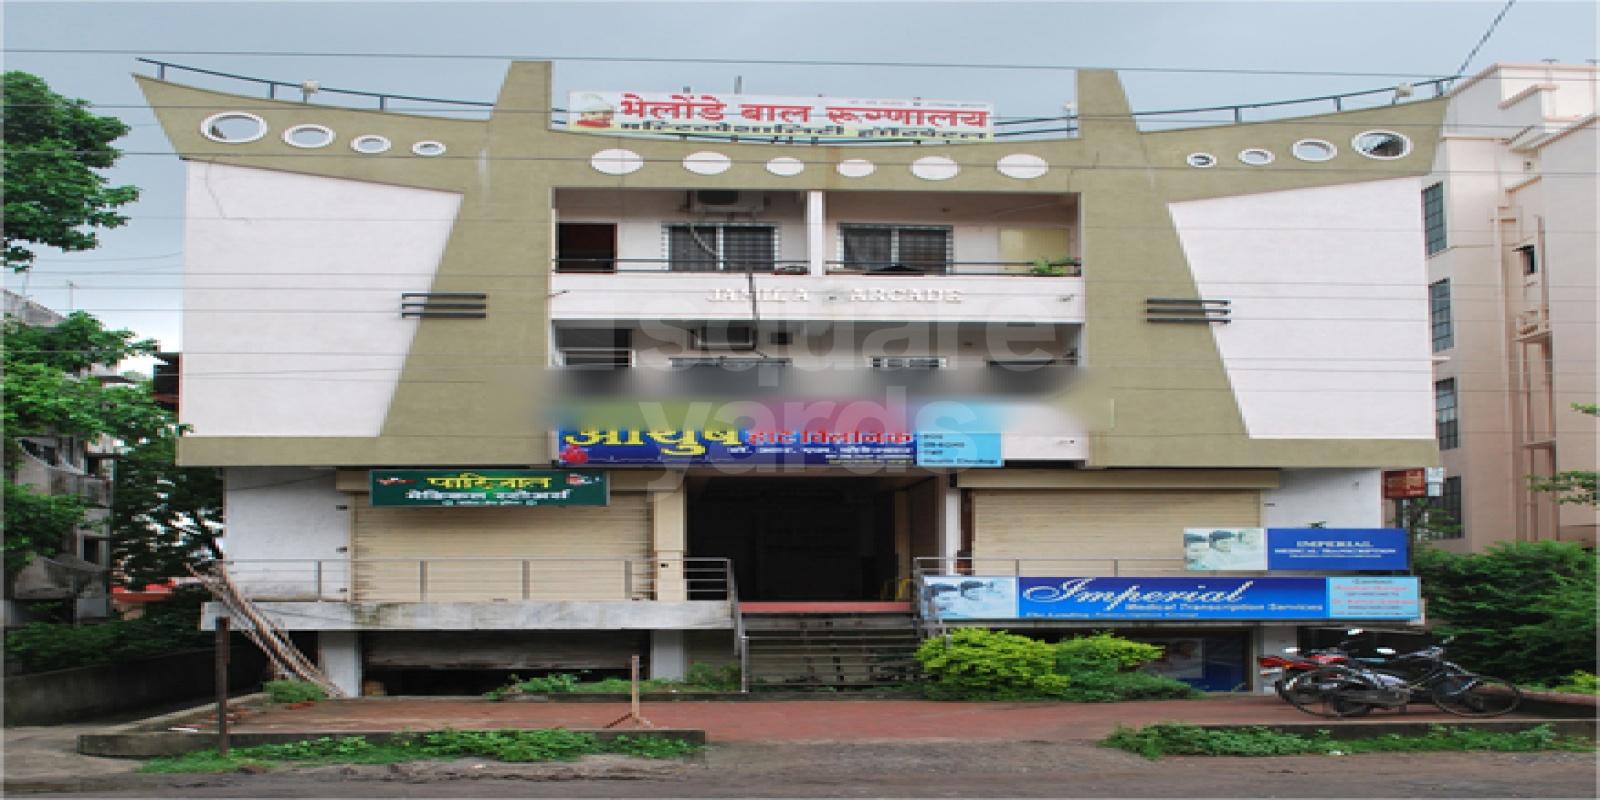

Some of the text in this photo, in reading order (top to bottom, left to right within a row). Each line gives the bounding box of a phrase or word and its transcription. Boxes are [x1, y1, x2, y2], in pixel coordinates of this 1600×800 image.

[620, 92, 727, 121] भेलोंडे
[738, 103, 813, 123] बाल
[848, 288, 963, 304] ARCADE
[1022, 576, 1254, 611] Imperial
[1179, 603, 1265, 612] Transcription
